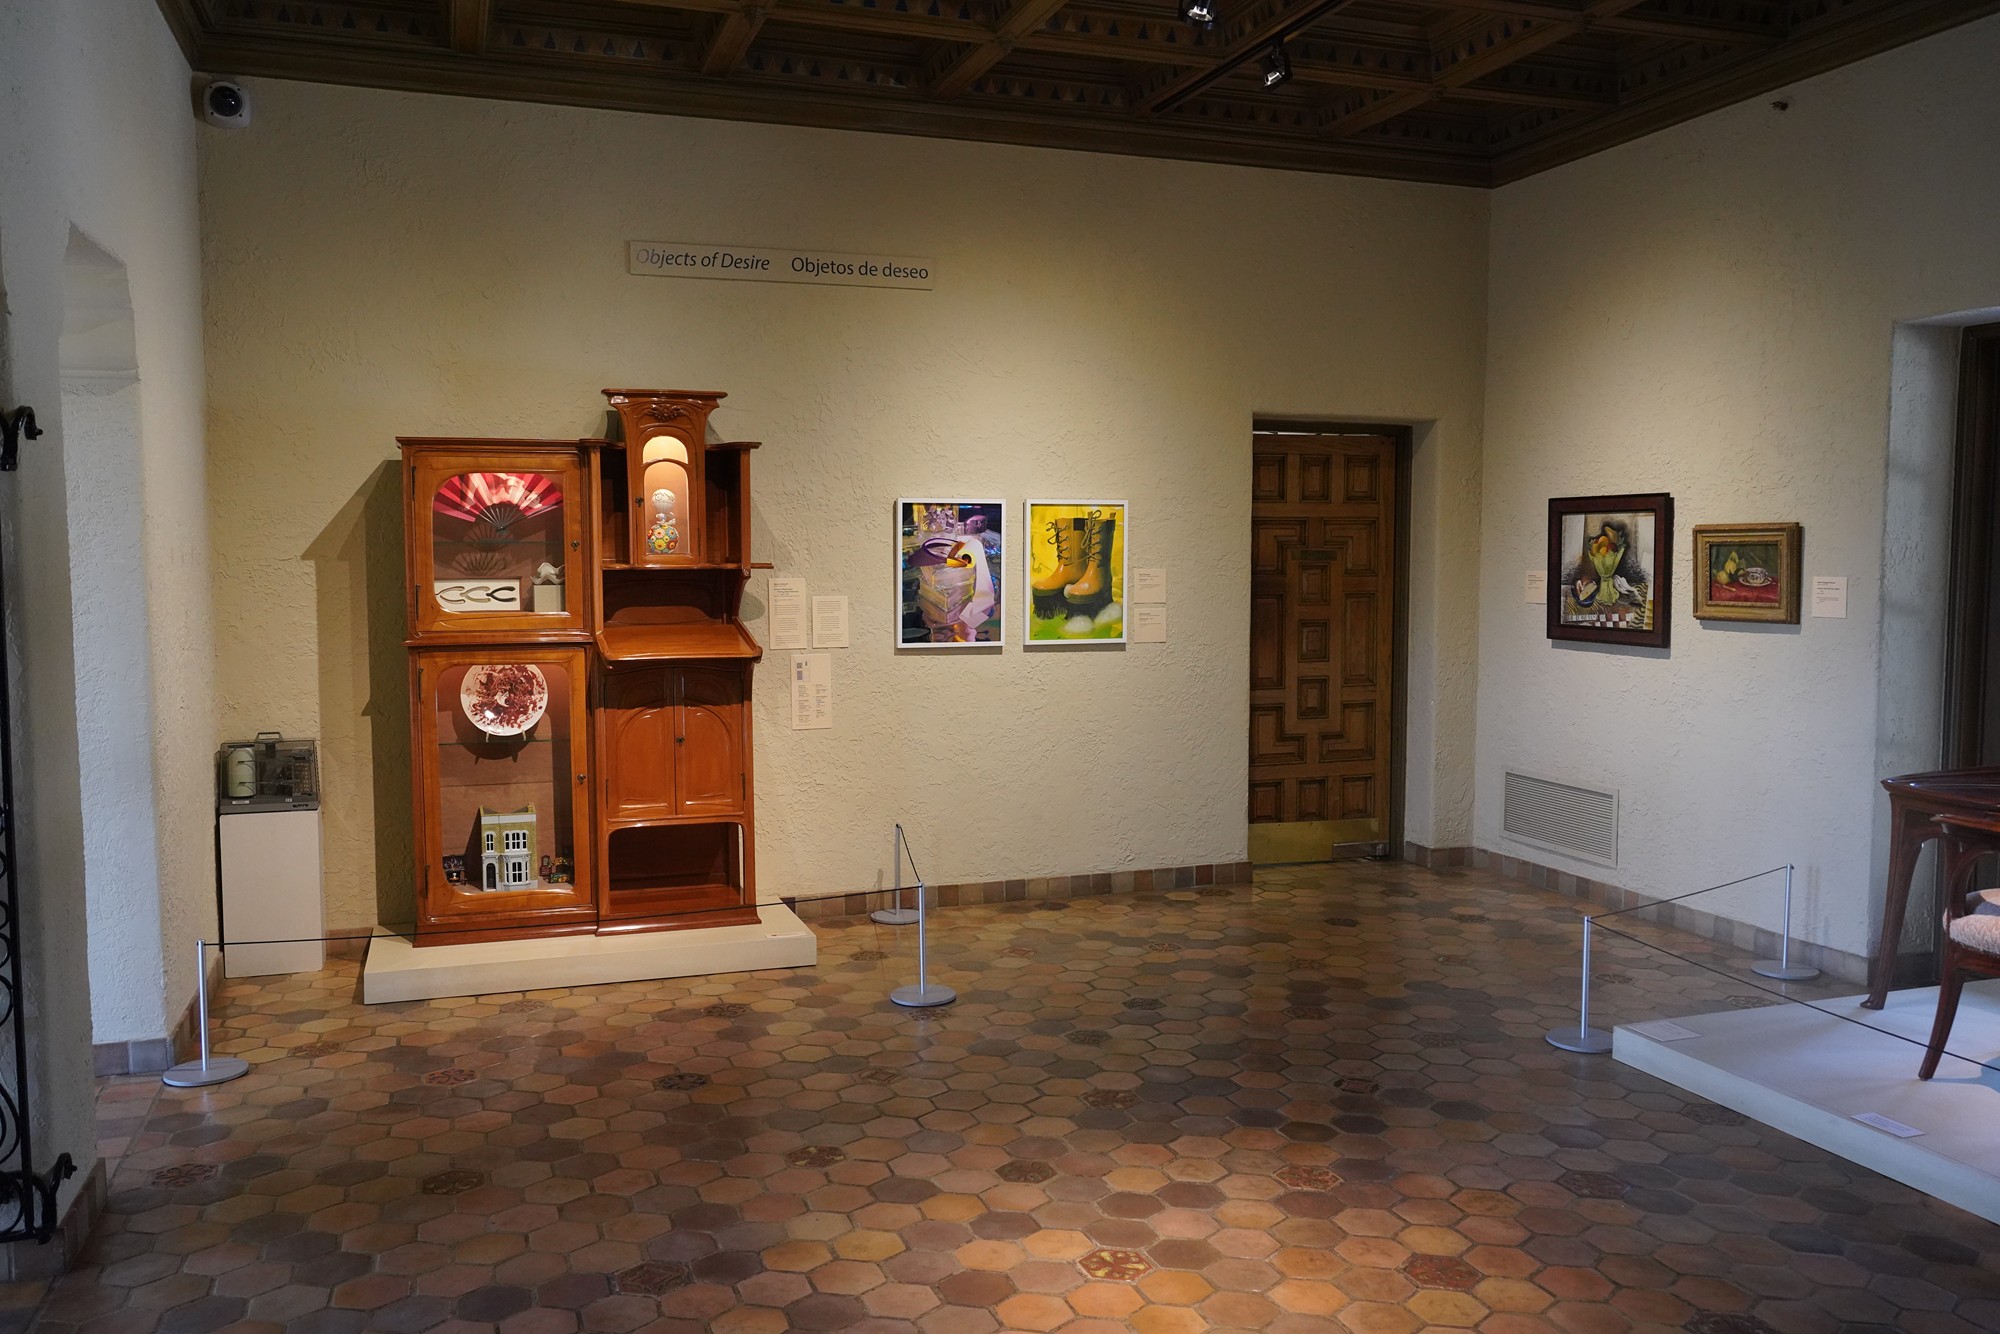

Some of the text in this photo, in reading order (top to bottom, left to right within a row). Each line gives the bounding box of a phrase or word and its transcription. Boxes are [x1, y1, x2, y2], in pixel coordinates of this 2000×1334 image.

[636, 248, 770, 271] Objects of Desire
[791, 257, 929, 280] Objetos de deseo
